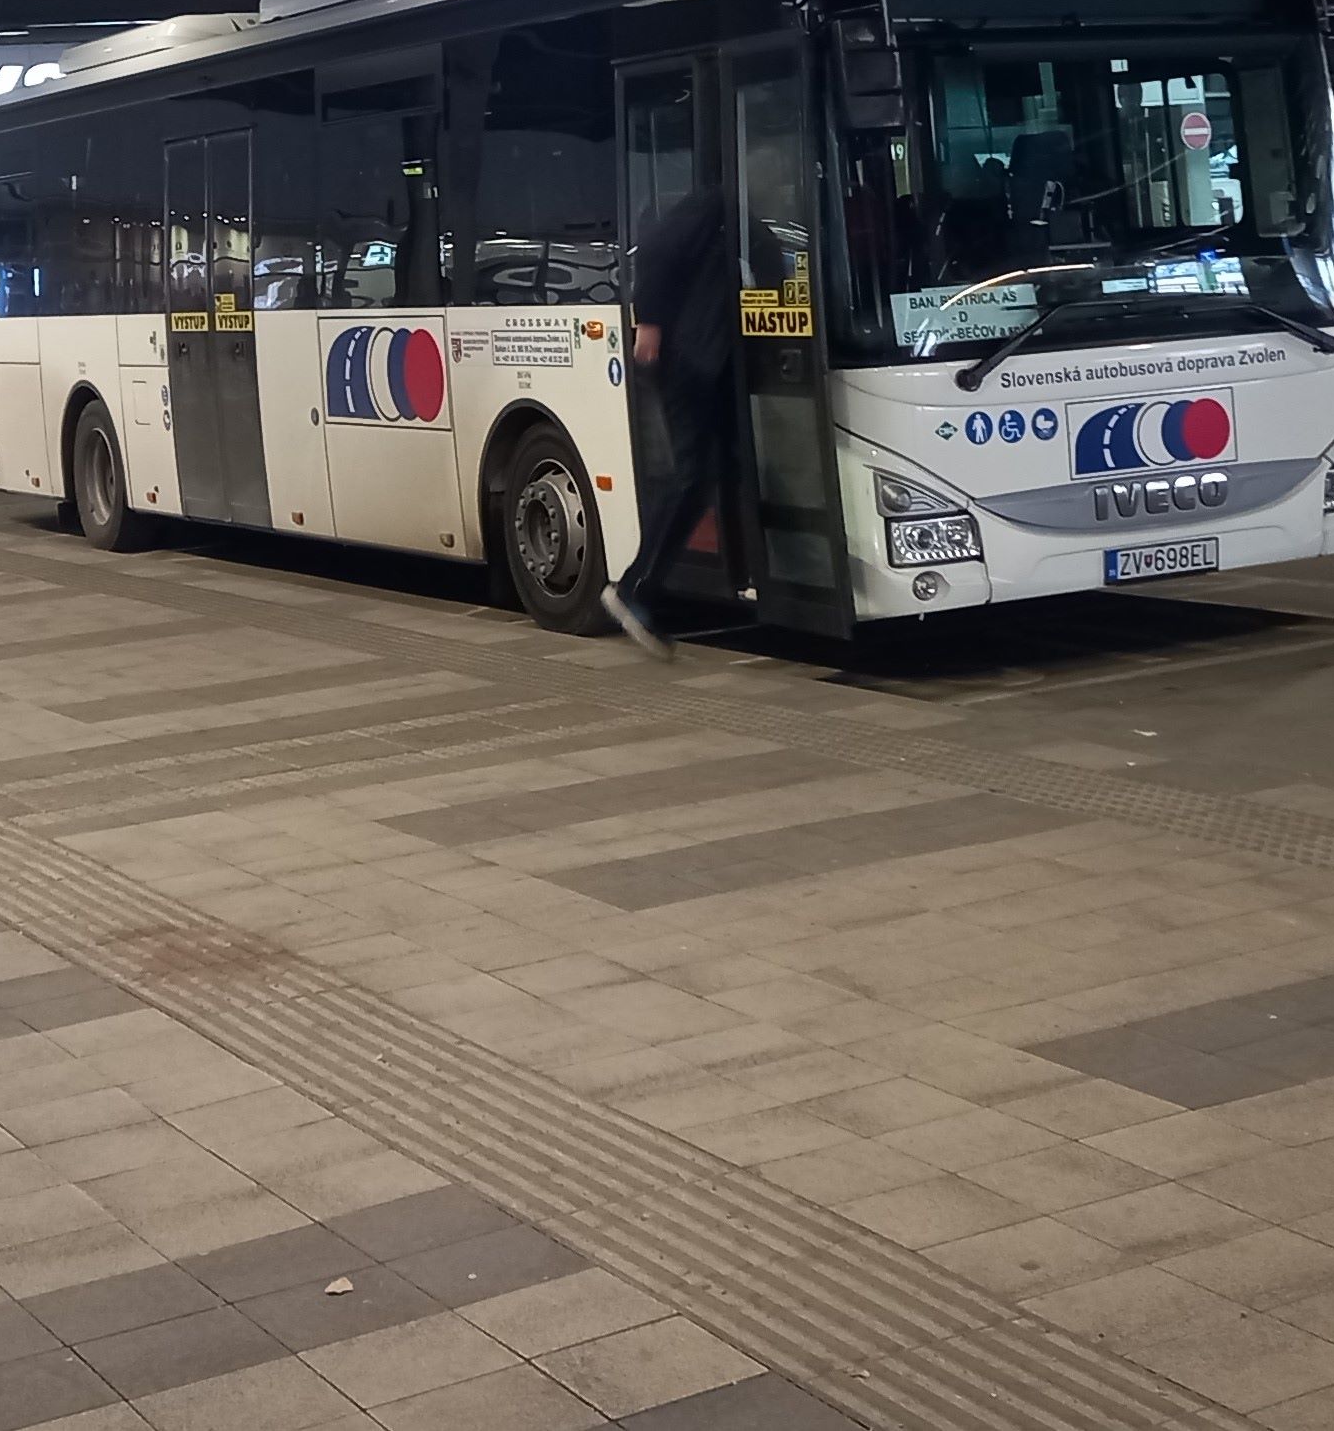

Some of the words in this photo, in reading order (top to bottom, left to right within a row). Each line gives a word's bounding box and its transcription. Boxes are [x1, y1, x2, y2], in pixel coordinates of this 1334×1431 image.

[506, 319, 567, 327] CROSSWAY
[745, 308, 808, 333] NÁSTUP
[1001, 366, 1082, 389] Slovenská
[1085, 358, 1173, 381] autobusová
[1177, 354, 1235, 374] doprava
[1238, 347, 1286, 366] Zvolen
[1095, 472, 1228, 521] IVECO
